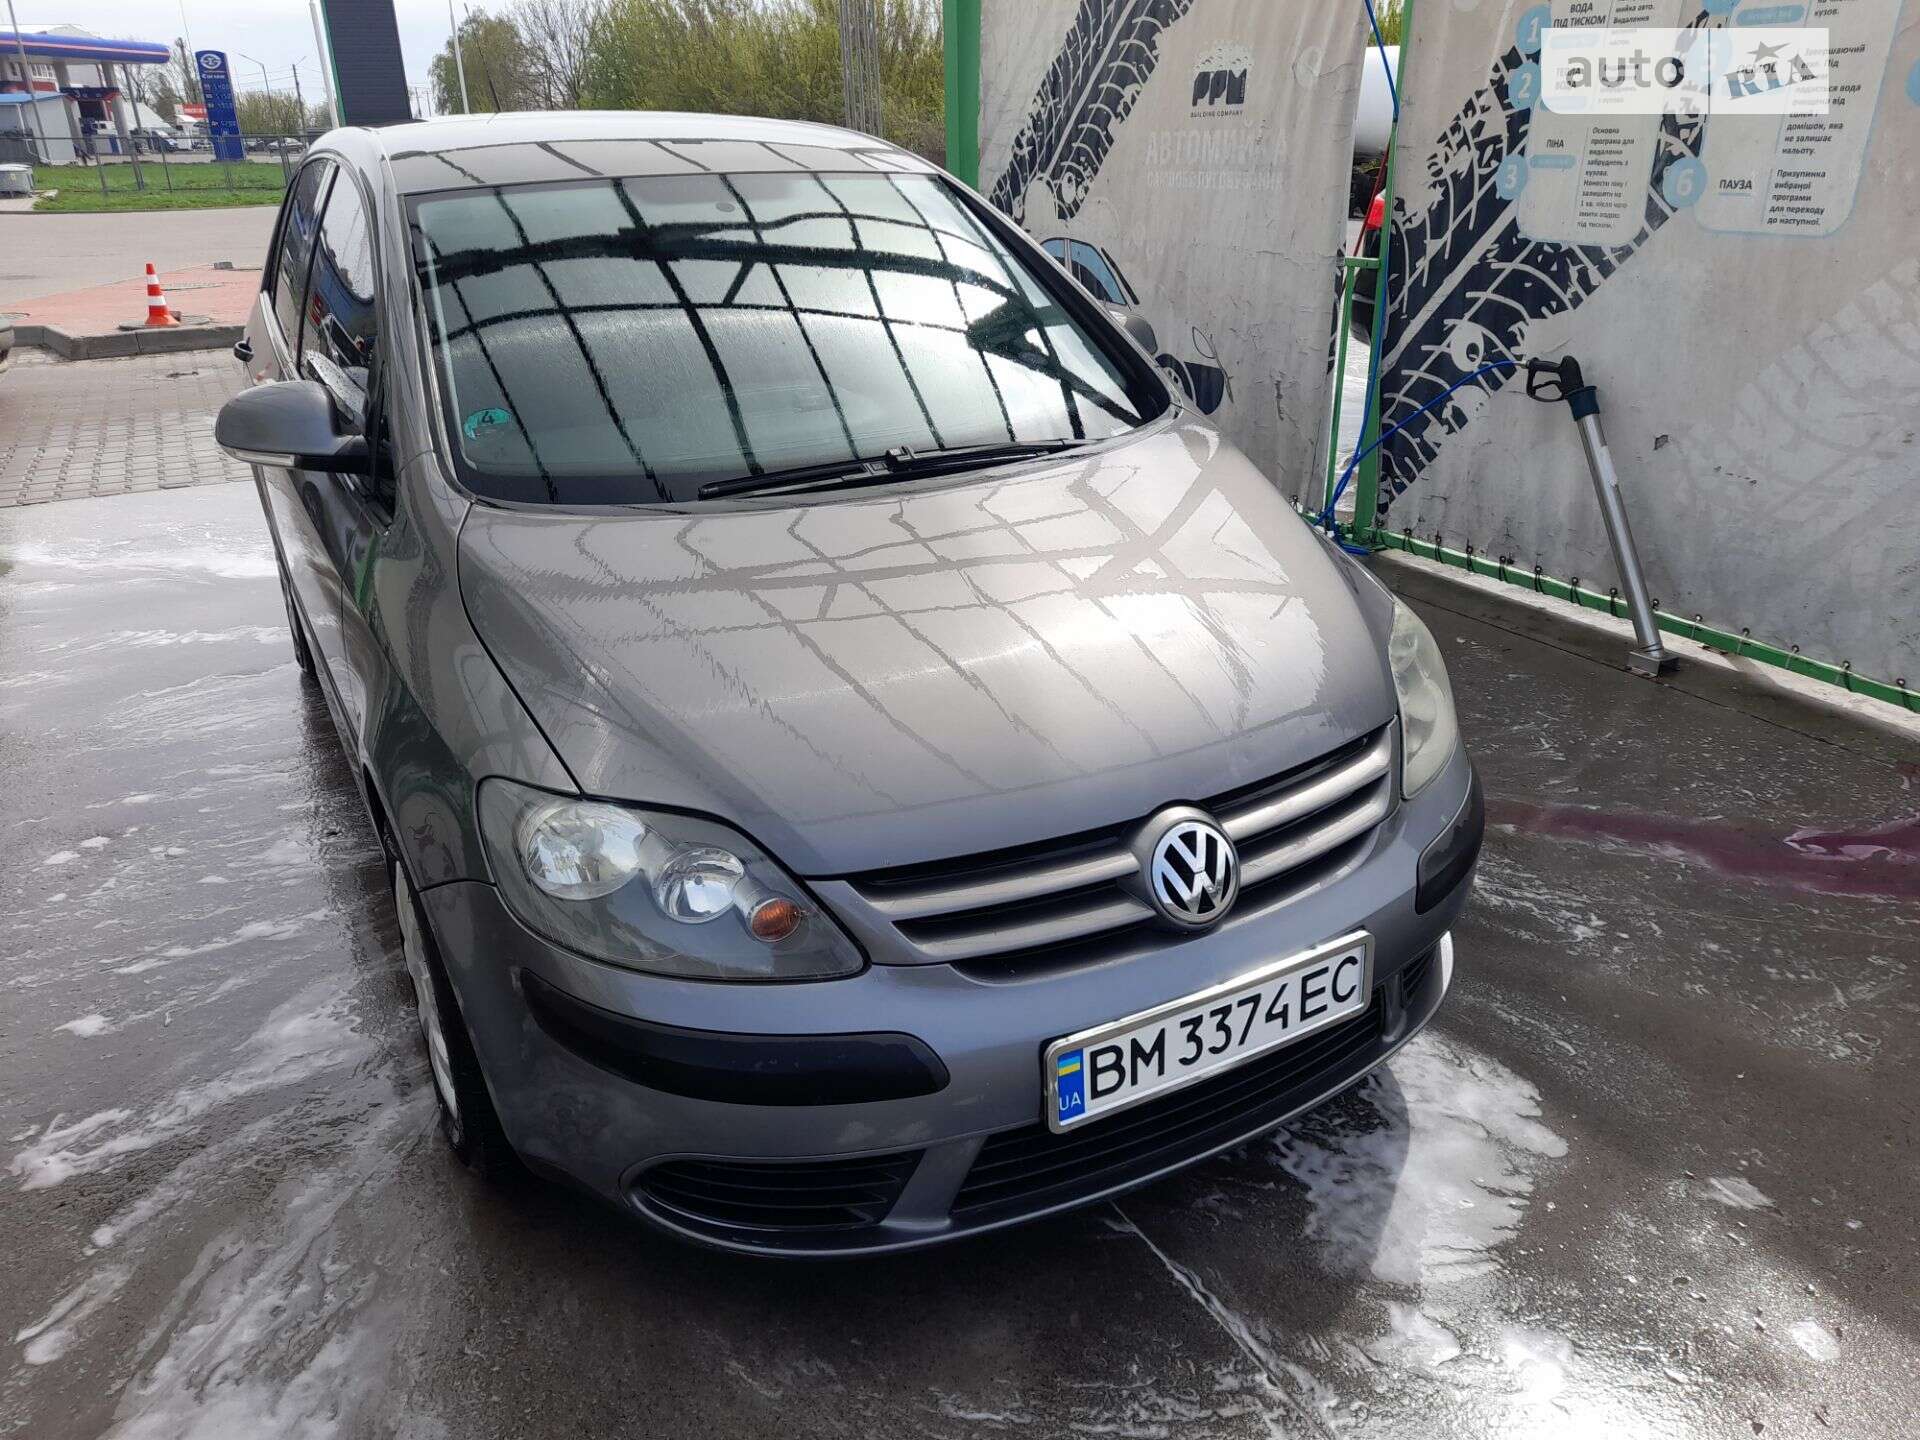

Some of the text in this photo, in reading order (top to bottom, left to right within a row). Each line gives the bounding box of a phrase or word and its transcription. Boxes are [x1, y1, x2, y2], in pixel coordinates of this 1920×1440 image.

[1570, 2, 1593, 14] ВОДА
[1570, 15, 1606, 26] ТИСКОМ
[1528, 16, 1540, 43] 1
[1519, 73, 1531, 98] 2
[1546, 139, 1564, 148] ПІНА
[1506, 164, 1518, 189] 3
[1676, 168, 1695, 196] 6
[1719, 179, 1752, 189] ПАУЗА
[1786, 206, 1825, 216] переходу
[1767, 217, 1778, 225] до
[482, 410, 496, 424] 4
[1090, 955, 1360, 1101] BM 3374 EC
[1059, 1090, 1082, 1110] UA
